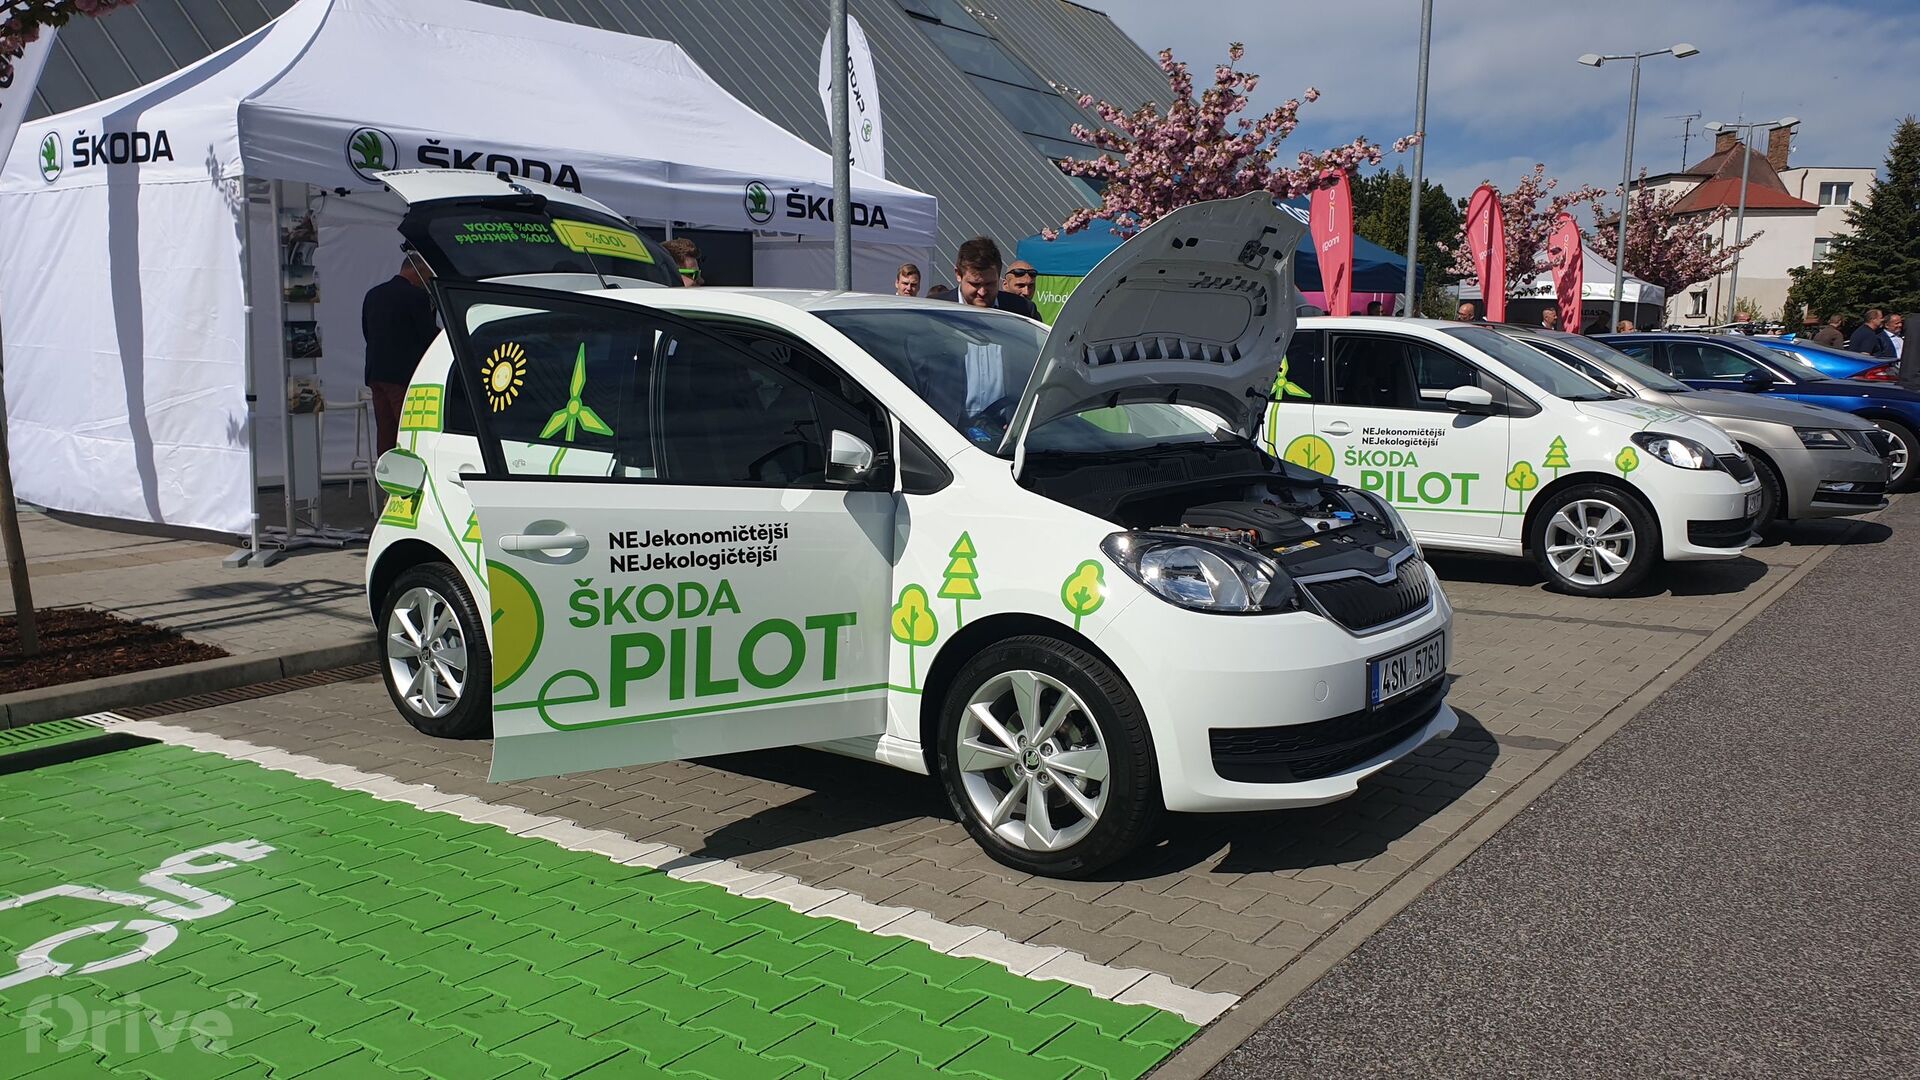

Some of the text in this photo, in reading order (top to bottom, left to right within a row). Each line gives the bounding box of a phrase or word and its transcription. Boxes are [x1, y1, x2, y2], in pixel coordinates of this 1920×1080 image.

[72, 129, 174, 168] ŠKODA
[786, 187, 889, 230] ŠKDA
[513, 222, 548, 232] 100%
[520, 232, 555, 243] 100%
[585, 231, 626, 248] 100%
[1362, 427, 1446, 438] NEJekonomičtější
[1362, 437, 1440, 448] NEJekologičtější
[1344, 445, 1419, 468] ŠKODA
[609, 522, 790, 550] NEJekonomičtější
[610, 545, 779, 574] NEJekologičtější
[568, 578, 741, 629] ŠKODA
[1382, 656, 1407, 694] 4SN
[1415, 641, 1440, 680] 5763
